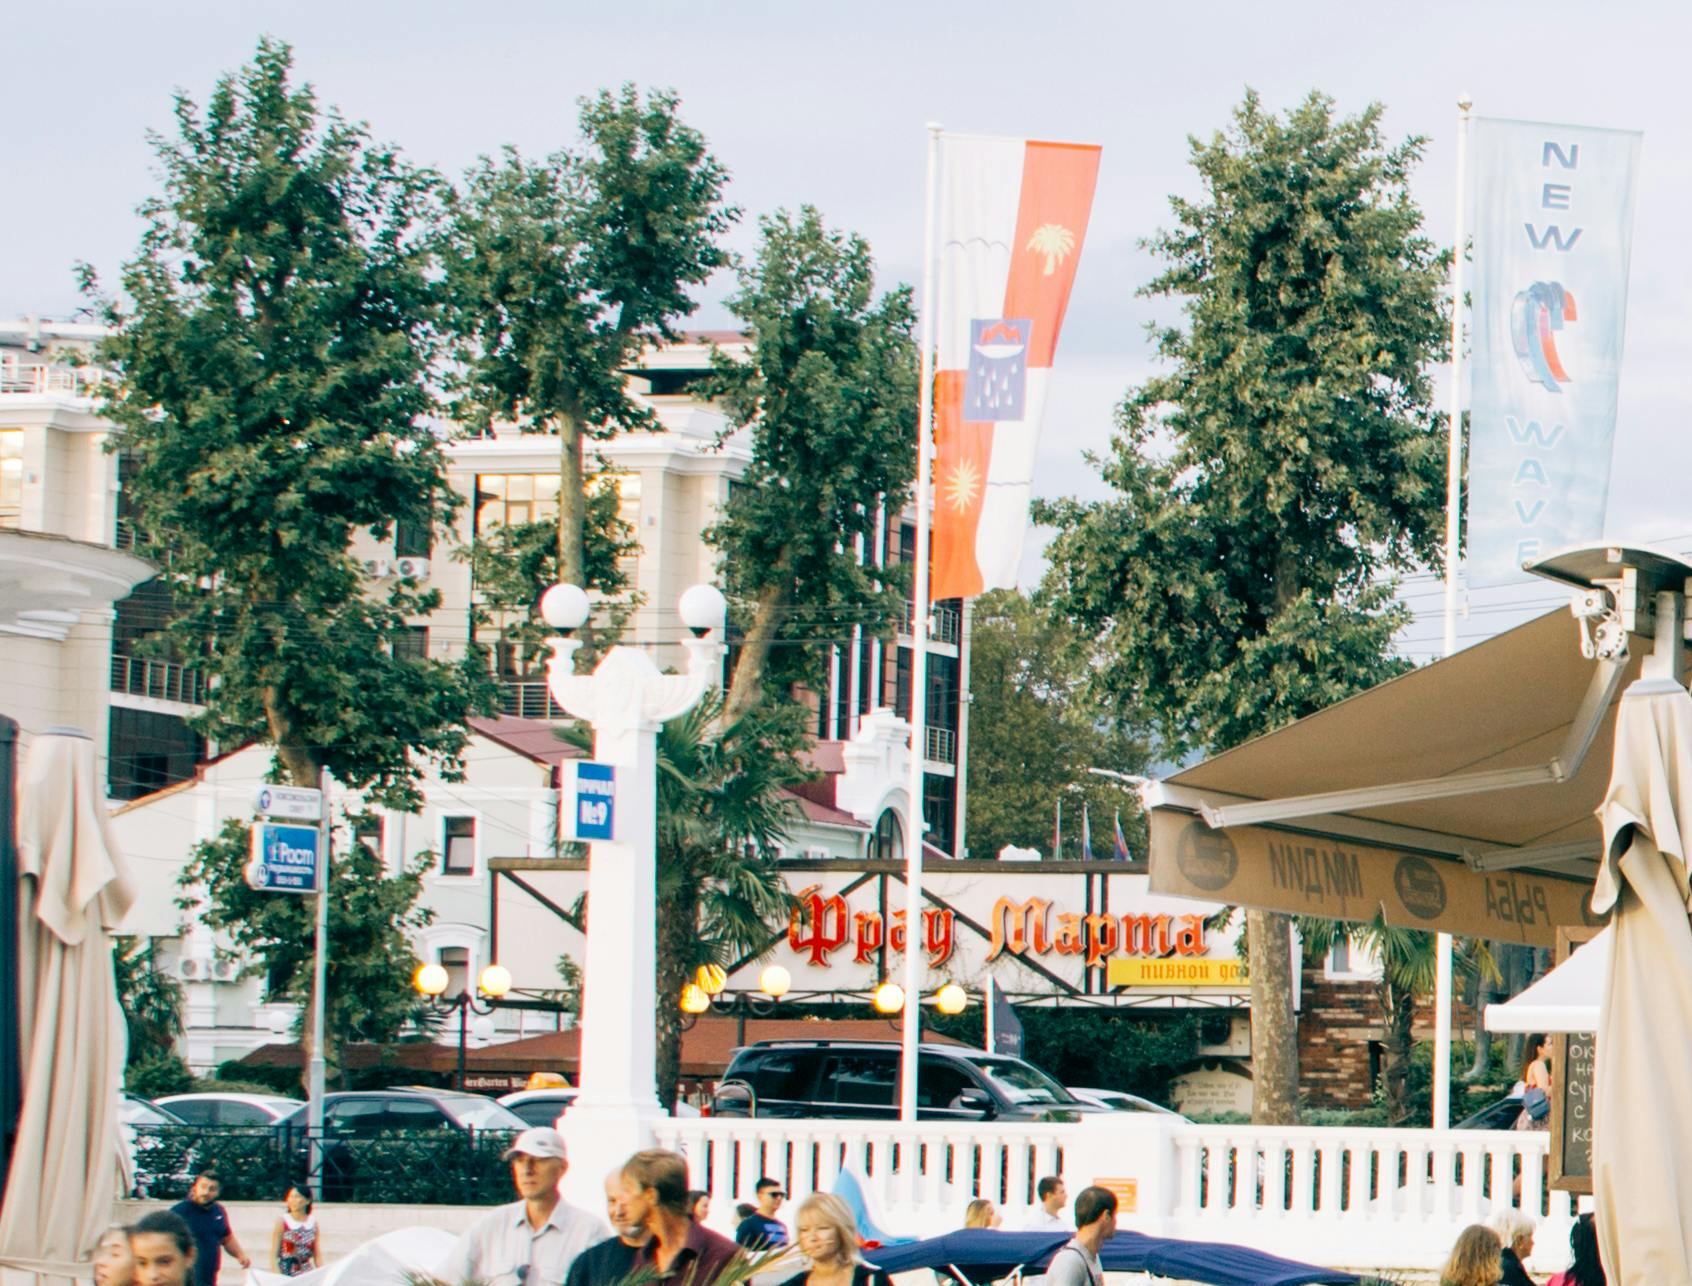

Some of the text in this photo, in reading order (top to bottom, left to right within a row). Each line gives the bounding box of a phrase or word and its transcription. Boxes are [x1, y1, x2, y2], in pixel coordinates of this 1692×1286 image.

[1524, 141, 1583, 252] NEW
[1505, 415, 1565, 570] WAVE
[985, 894, 1210, 969] Марта
